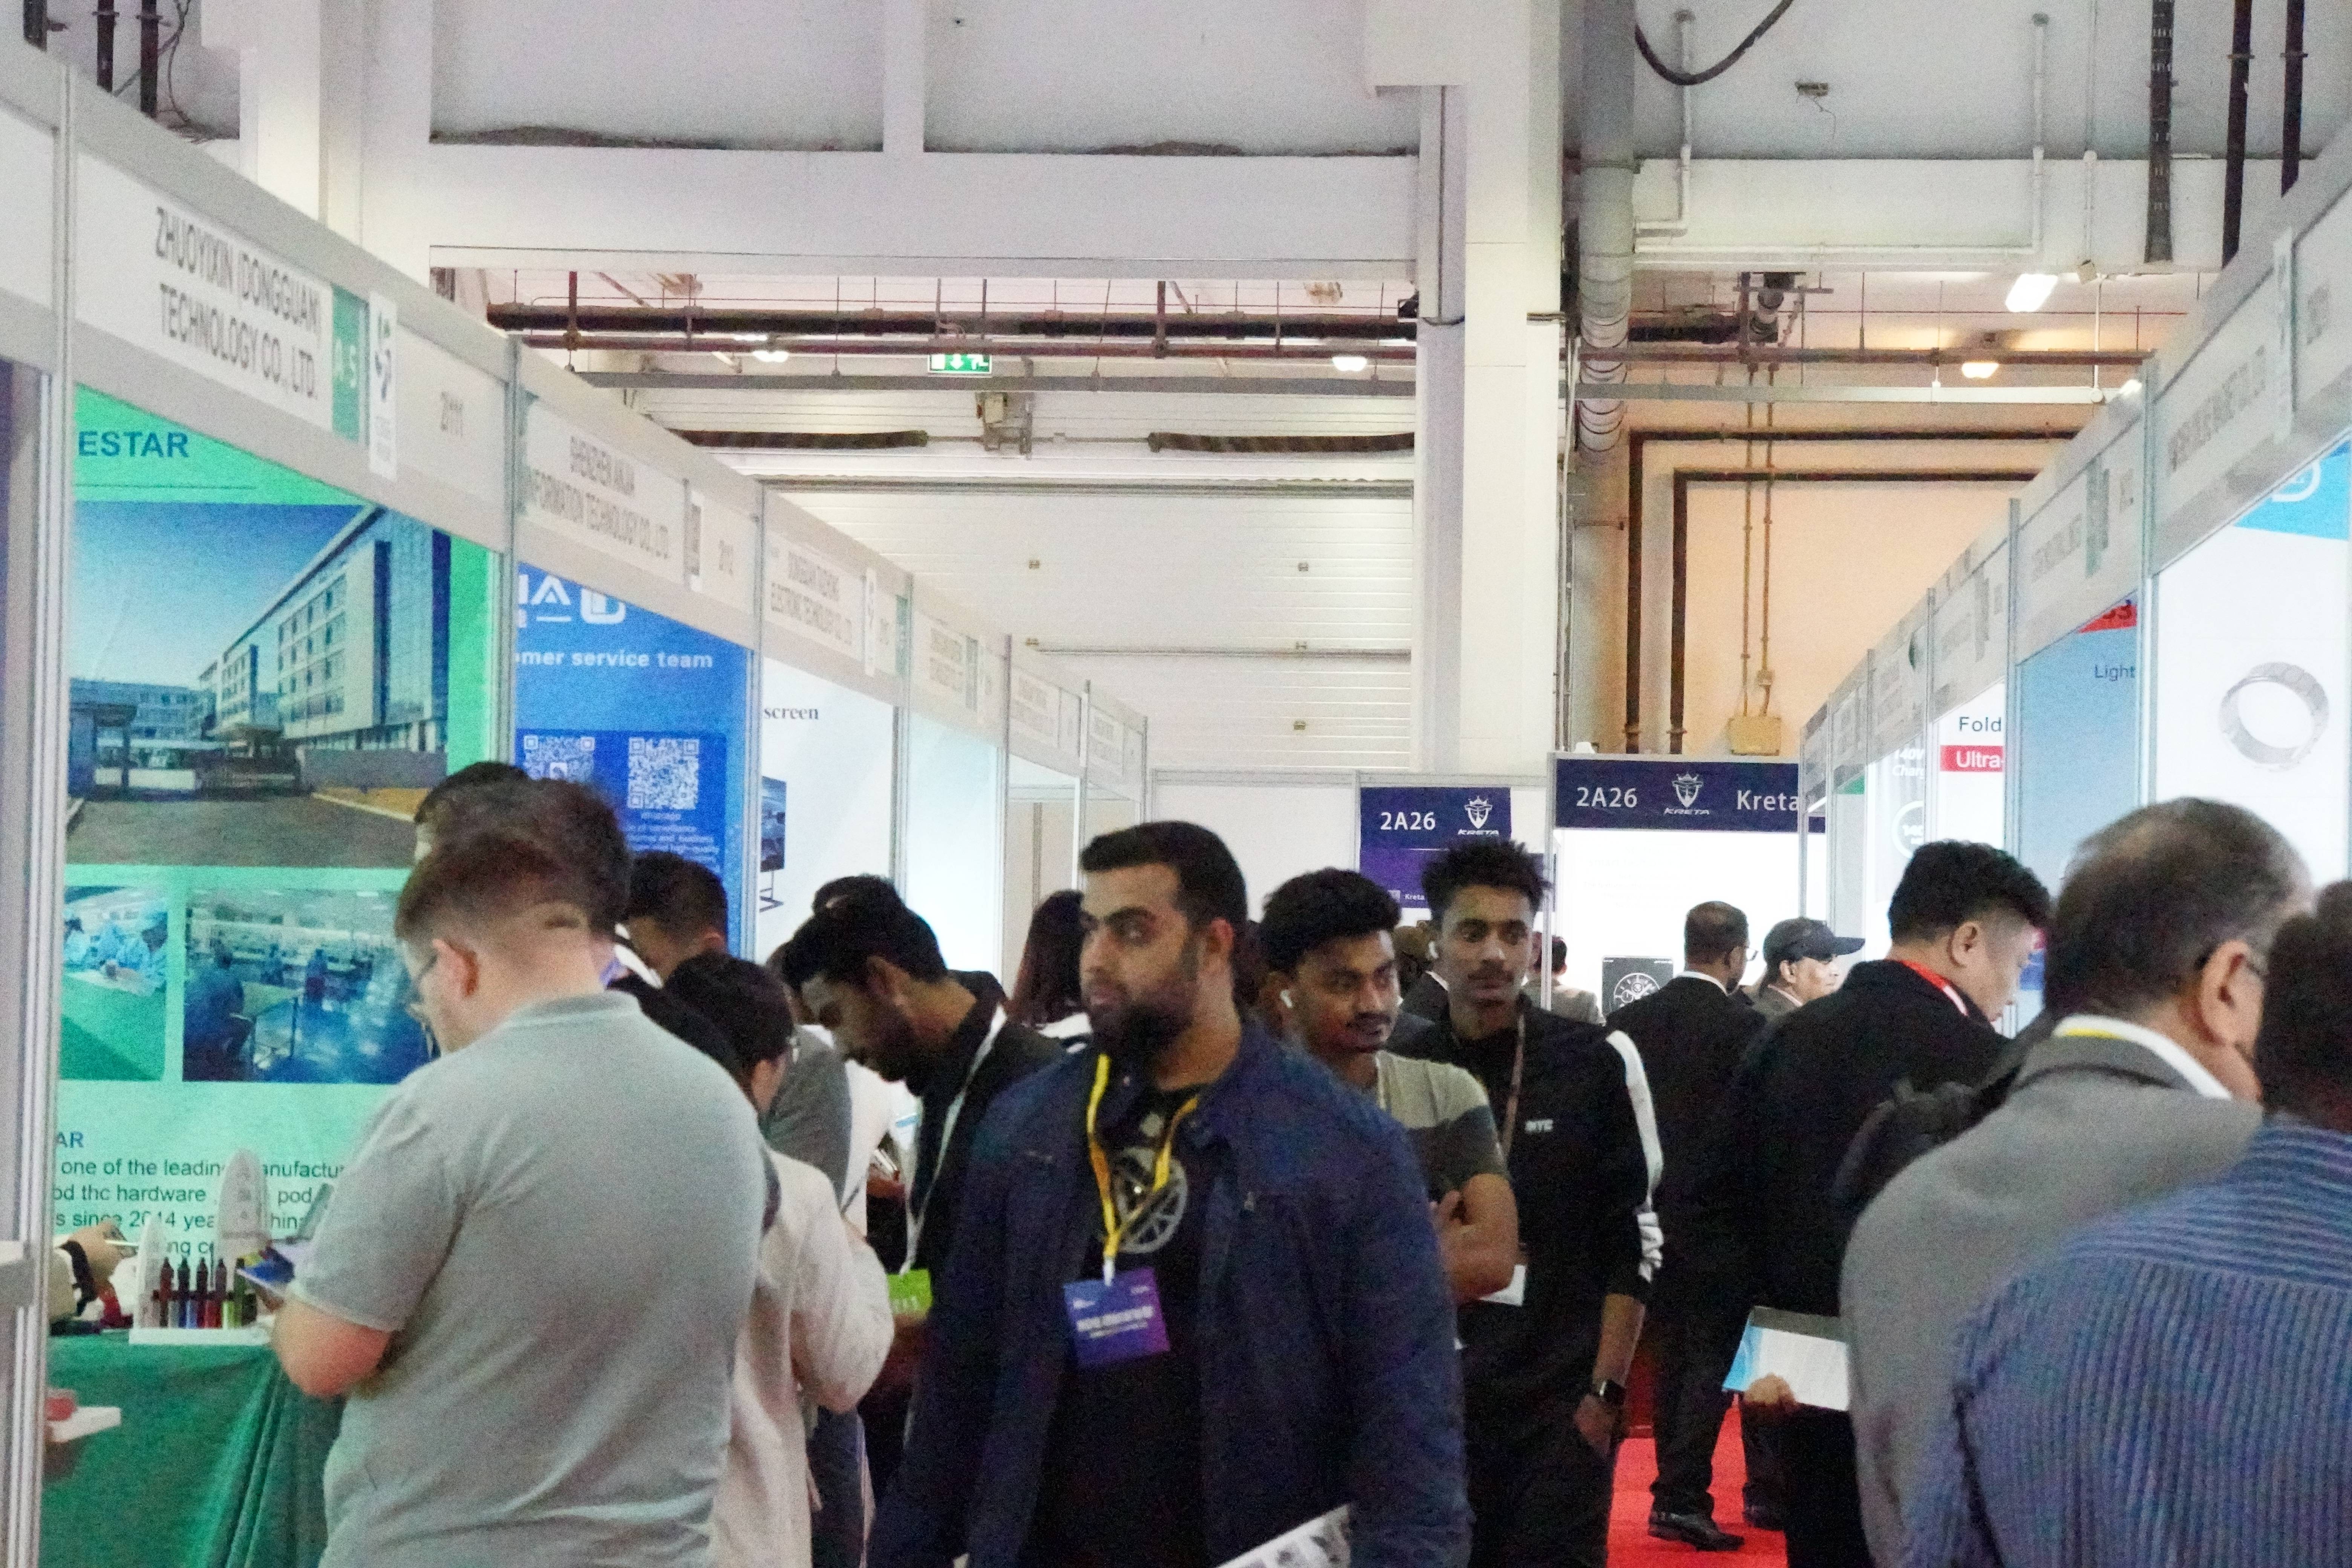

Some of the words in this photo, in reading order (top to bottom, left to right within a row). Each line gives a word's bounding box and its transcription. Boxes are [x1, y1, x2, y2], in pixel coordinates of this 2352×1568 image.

[159, 283, 259, 372] TECHNOLOGY
[78, 431, 188, 457] ESTAR
[571, 649, 650, 667] service
[657, 652, 713, 668] team
[2094, 665, 2135, 681] Light
[763, 707, 819, 720] screen
[1960, 717, 2001, 732] Fold
[1577, 787, 1637, 808] 2A26
[1737, 790, 1799, 811] Kreta
[1380, 811, 1436, 830] 2A26
[56, 1131, 84, 1148] AR
[61, 1161, 96, 1175] one
[103, 1158, 122, 1175] of
[128, 1158, 158, 1176] the
[164, 1158, 225, 1177] leadin
[116, 1184, 206, 1202] hardware
[277, 1187, 312, 1206] pod
